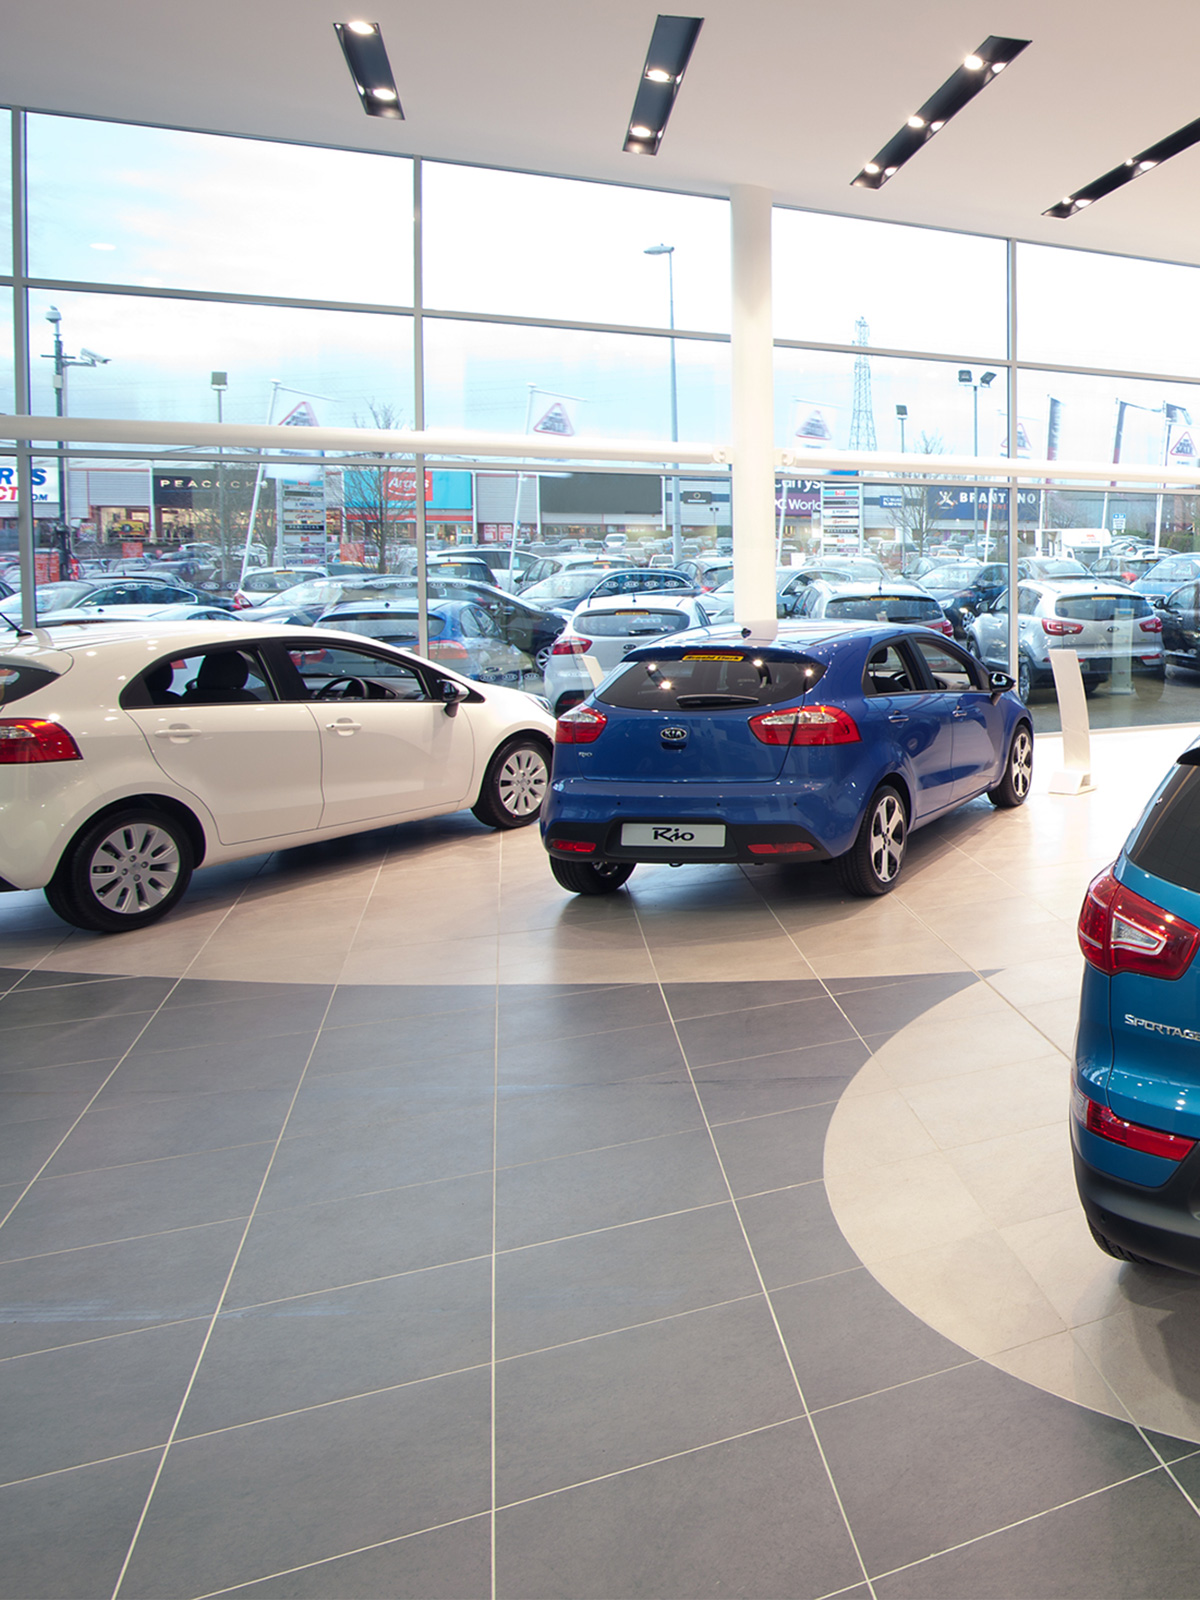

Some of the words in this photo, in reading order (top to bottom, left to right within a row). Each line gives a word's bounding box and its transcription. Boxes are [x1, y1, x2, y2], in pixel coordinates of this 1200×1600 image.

[0, 467, 47, 486] RS
[160, 480, 268, 489] PEACCK
[960, 492, 1036, 504] BRANTNO
[652, 827, 695, 842] Rio
